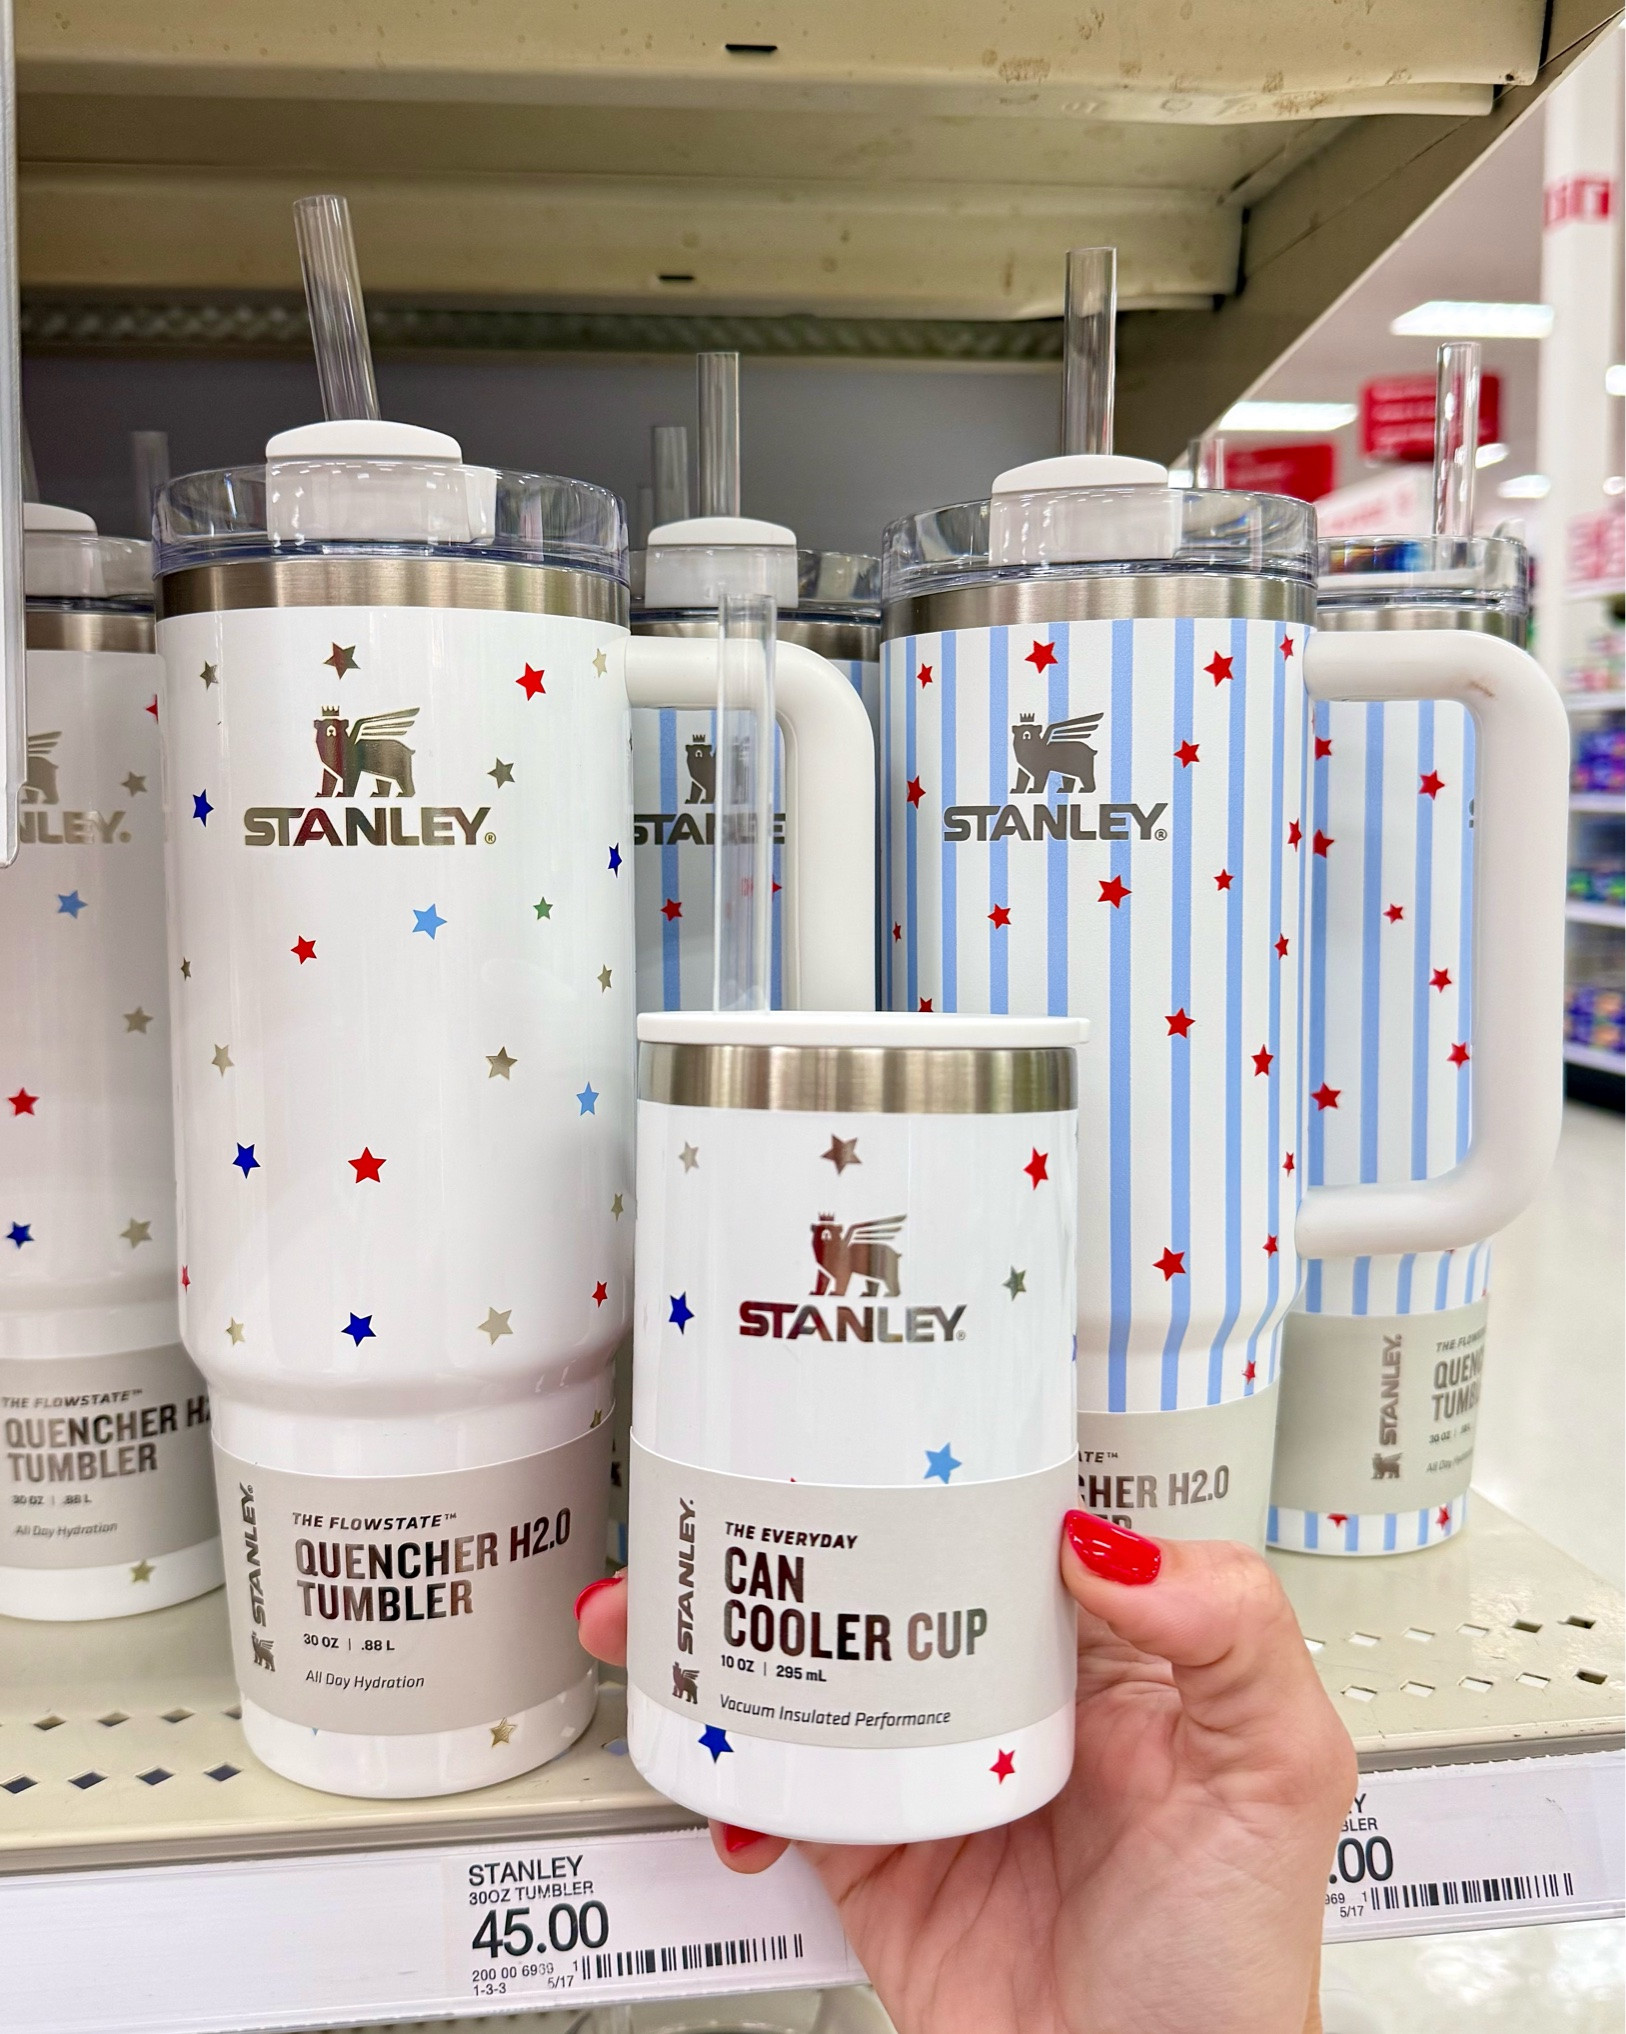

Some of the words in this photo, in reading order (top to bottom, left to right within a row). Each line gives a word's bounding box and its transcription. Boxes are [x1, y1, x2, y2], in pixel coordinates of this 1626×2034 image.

[5, 1403, 178, 1449] QUENCHER
[7, 1442, 158, 1483] TUMBLER
[1168, 1464, 1229, 1506] H2.0
[33, 1525, 55, 1538] Day
[57, 1522, 118, 1538] Hydration
[293, 1512, 324, 1528] THE
[725, 1521, 756, 1540] THE
[761, 1527, 858, 1549] EVERYDAY
[295, 1532, 498, 1580] QUENCHER
[510, 1507, 571, 1562] H2.0
[724, 1546, 804, 1603] CAN
[297, 1579, 473, 1622] TUMBLER
[303, 1633, 319, 1646] 30
[322, 1636, 339, 1649] OZ
[361, 1639, 382, 1651] .88
[386, 1640, 395, 1651] L
[724, 1599, 892, 1661] COOLER
[907, 1608, 988, 1661] CUP
[305, 1669, 322, 1684] All
[326, 1673, 350, 1690] Day
[354, 1676, 425, 1691] Hydration
[721, 1654, 734, 1668] 10
[737, 1658, 755, 1673] OZ
[776, 1665, 803, 1680] 295
[806, 1669, 827, 1682] mL
[720, 1694, 775, 1718] Vacuum
[779, 1706, 850, 1726] Insulated
[854, 1711, 950, 1730] Performance
[468, 1855, 583, 1887] STANLEY
[1328, 1836, 1393, 1883] .00
[515, 1881, 594, 1901] TUMBLER
[1340, 1905, 1364, 1918] 5/17
[472, 1900, 609, 1958] 45.00
[472, 1968, 496, 1982] 200
[501, 1966, 517, 1979] 00
[473, 1982, 507, 1996] 1-3-3
[548, 1975, 574, 1989] 5/17
